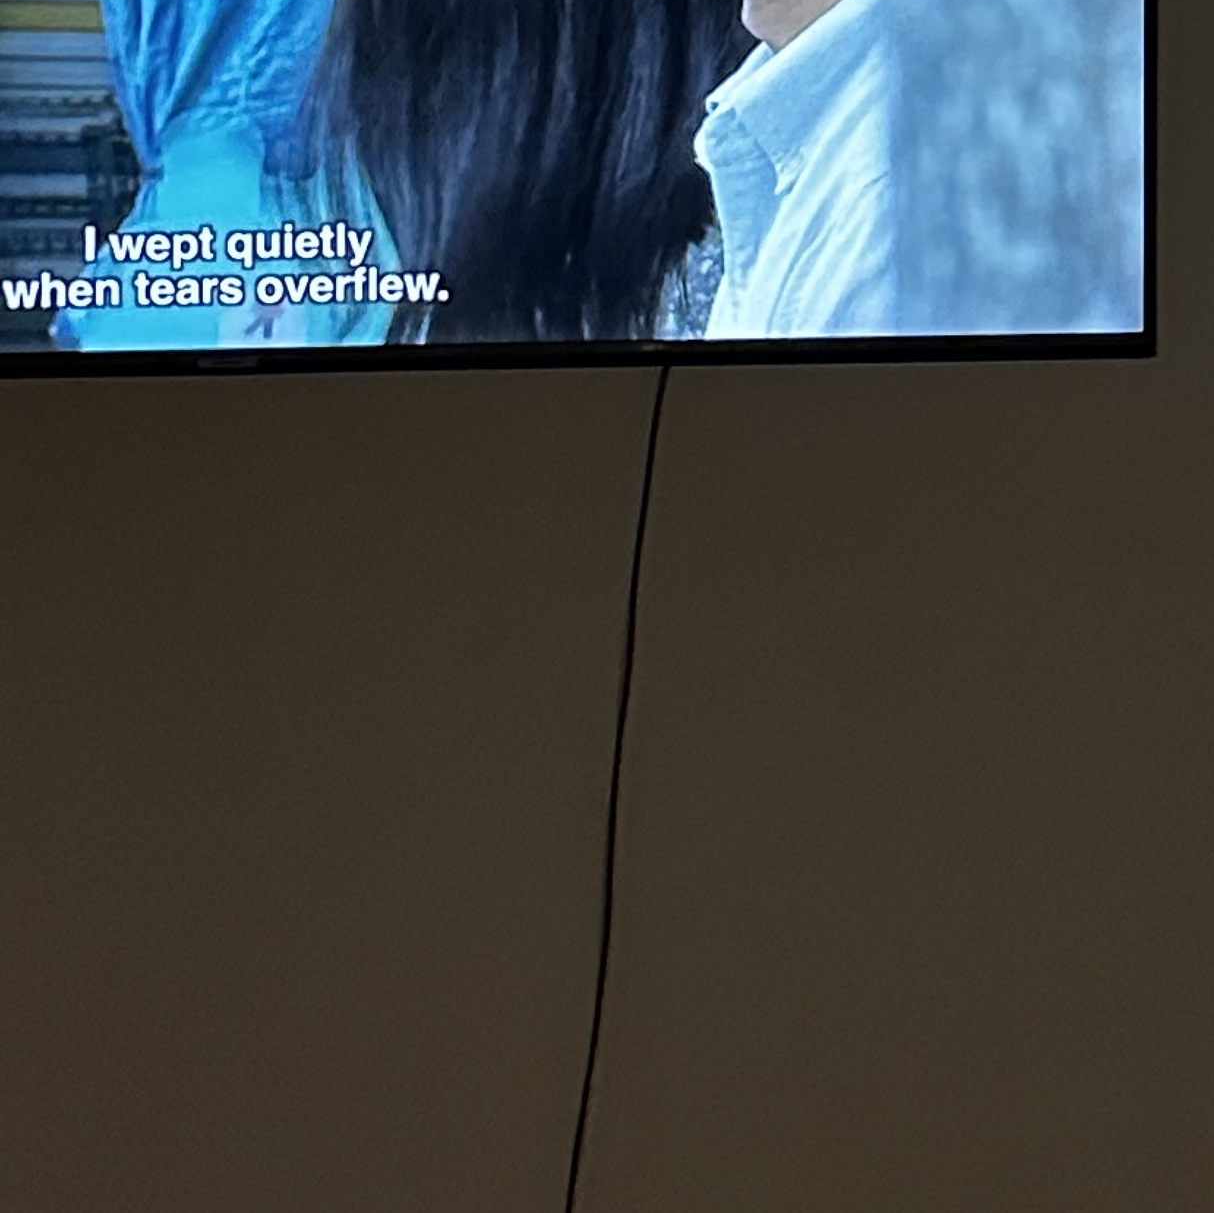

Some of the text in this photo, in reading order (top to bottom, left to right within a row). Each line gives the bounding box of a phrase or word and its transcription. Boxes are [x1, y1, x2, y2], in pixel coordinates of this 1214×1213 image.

[84, 223, 373, 268] I wept quietly
[2, 267, 450, 310] when tears overflew.
